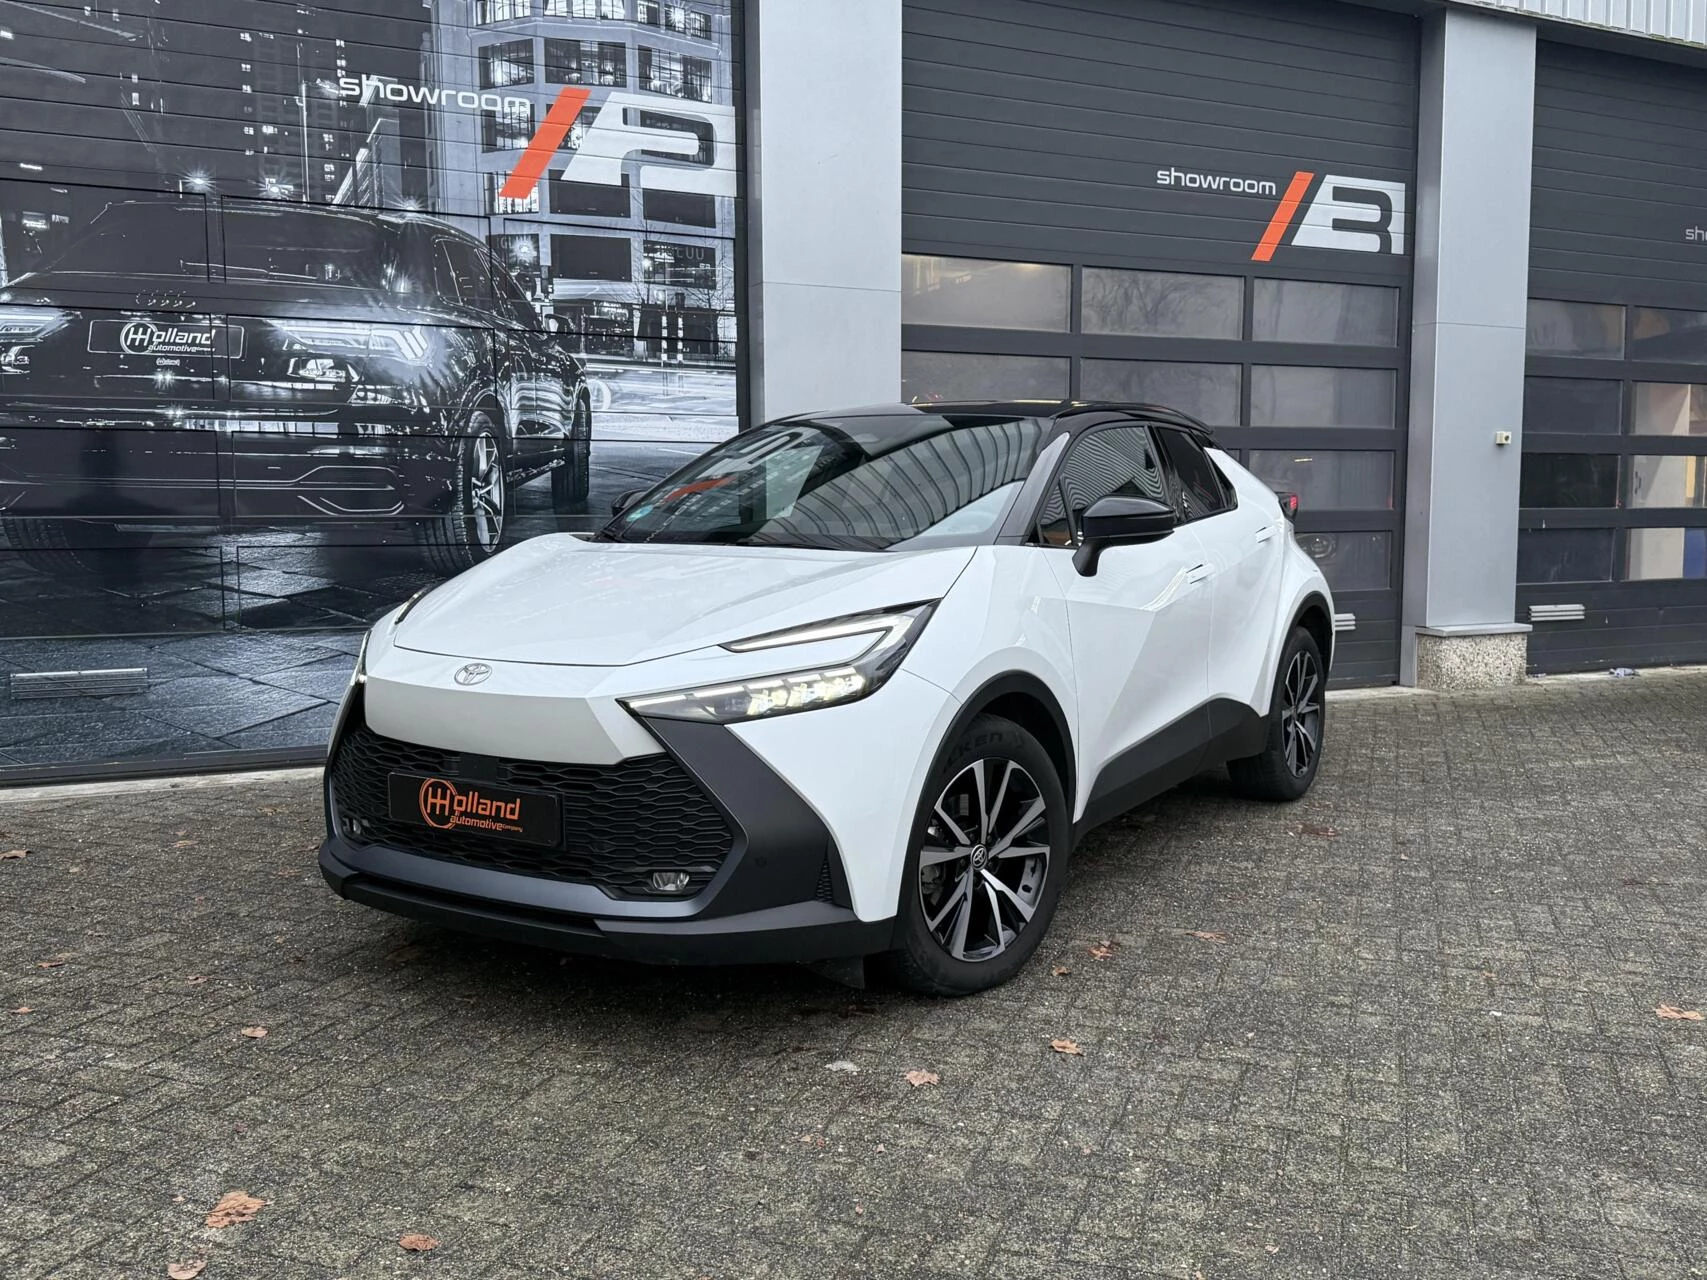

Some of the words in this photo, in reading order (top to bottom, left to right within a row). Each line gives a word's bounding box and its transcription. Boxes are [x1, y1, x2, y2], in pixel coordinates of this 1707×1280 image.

[338, 74, 531, 113] showroom
[1156, 167, 1277, 196] showroom
[1685, 225, 1707, 241] sh
[450, 814, 504, 832] automotive
